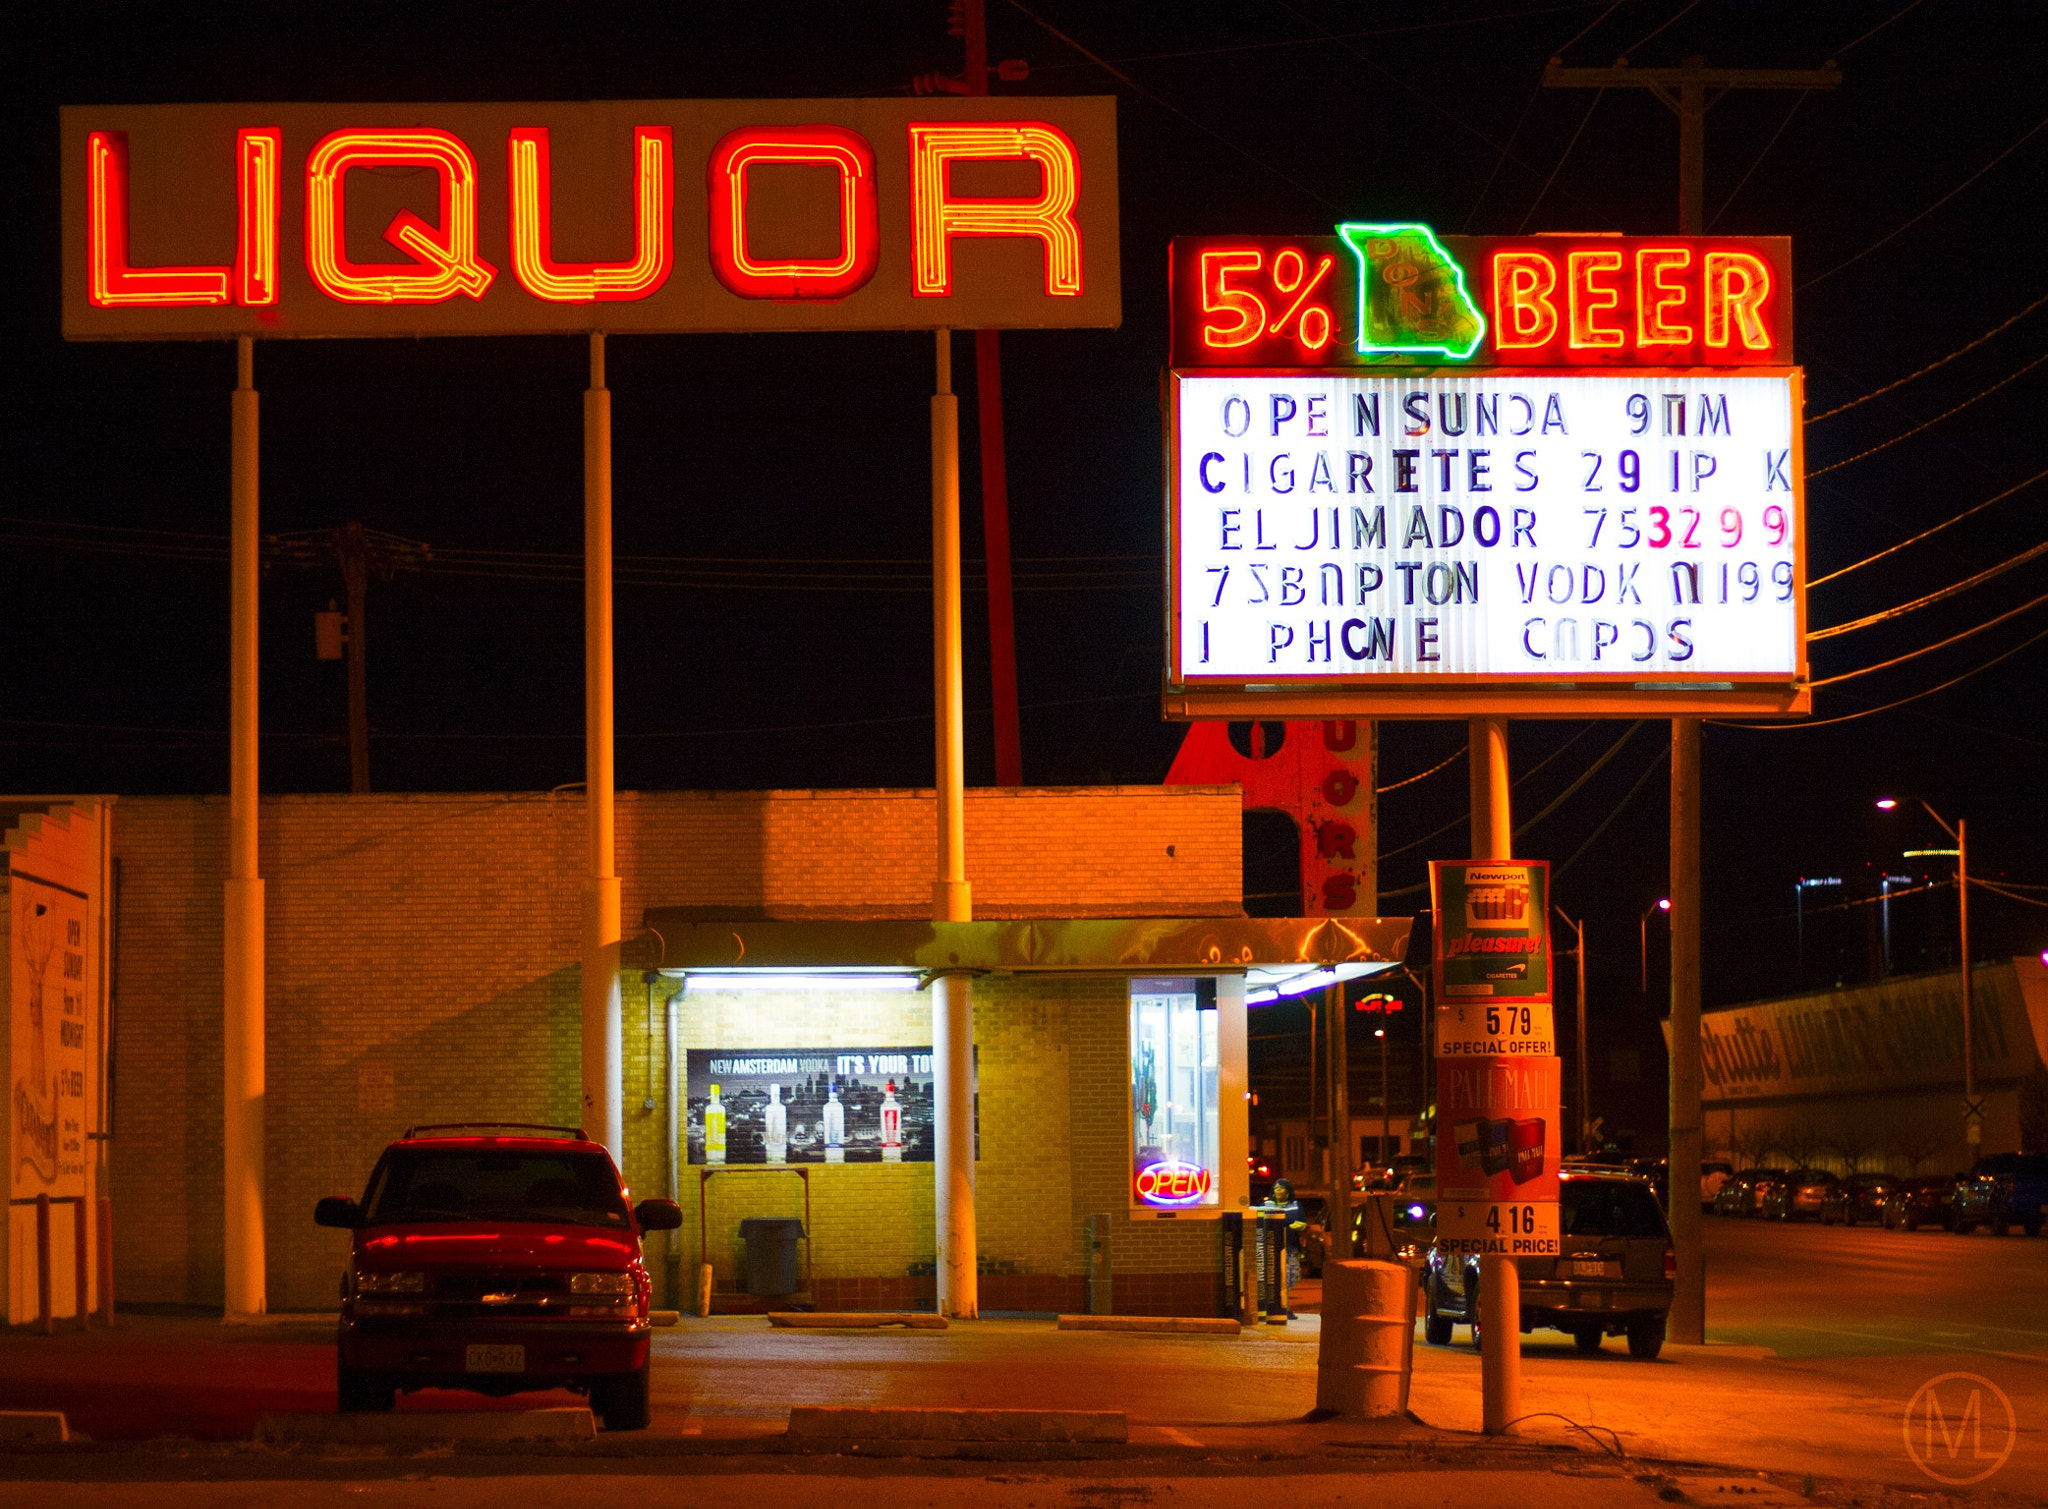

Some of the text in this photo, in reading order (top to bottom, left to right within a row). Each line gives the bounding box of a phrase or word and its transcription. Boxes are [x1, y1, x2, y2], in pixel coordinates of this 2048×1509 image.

[87, 121, 1083, 307] LIQUOR
[1199, 248, 1773, 351] 5% BEER
[1469, 872, 1526, 881] Newport
[1447, 932, 1542, 958] pleasure!
[1485, 971, 1518, 979] CIGARETTES
[1486, 1005, 1532, 1036] 5.79
[1443, 1039, 1552, 1054] SPECIAL OFFER!
[710, 1059, 732, 1074] NEW
[733, 1057, 798, 1074] AMSTERDAM
[800, 1057, 829, 1073] VODKA
[837, 1055, 865, 1075] IT'S
[868, 1054, 908, 1075] YOUR
[1450, 1068, 1553, 1109] PALL MALL
[1136, 1170, 1209, 1197] OPEN
[1485, 1204, 1535, 1235] 4.16
[1440, 1239, 1559, 1254] SPECIAL PRICE!
